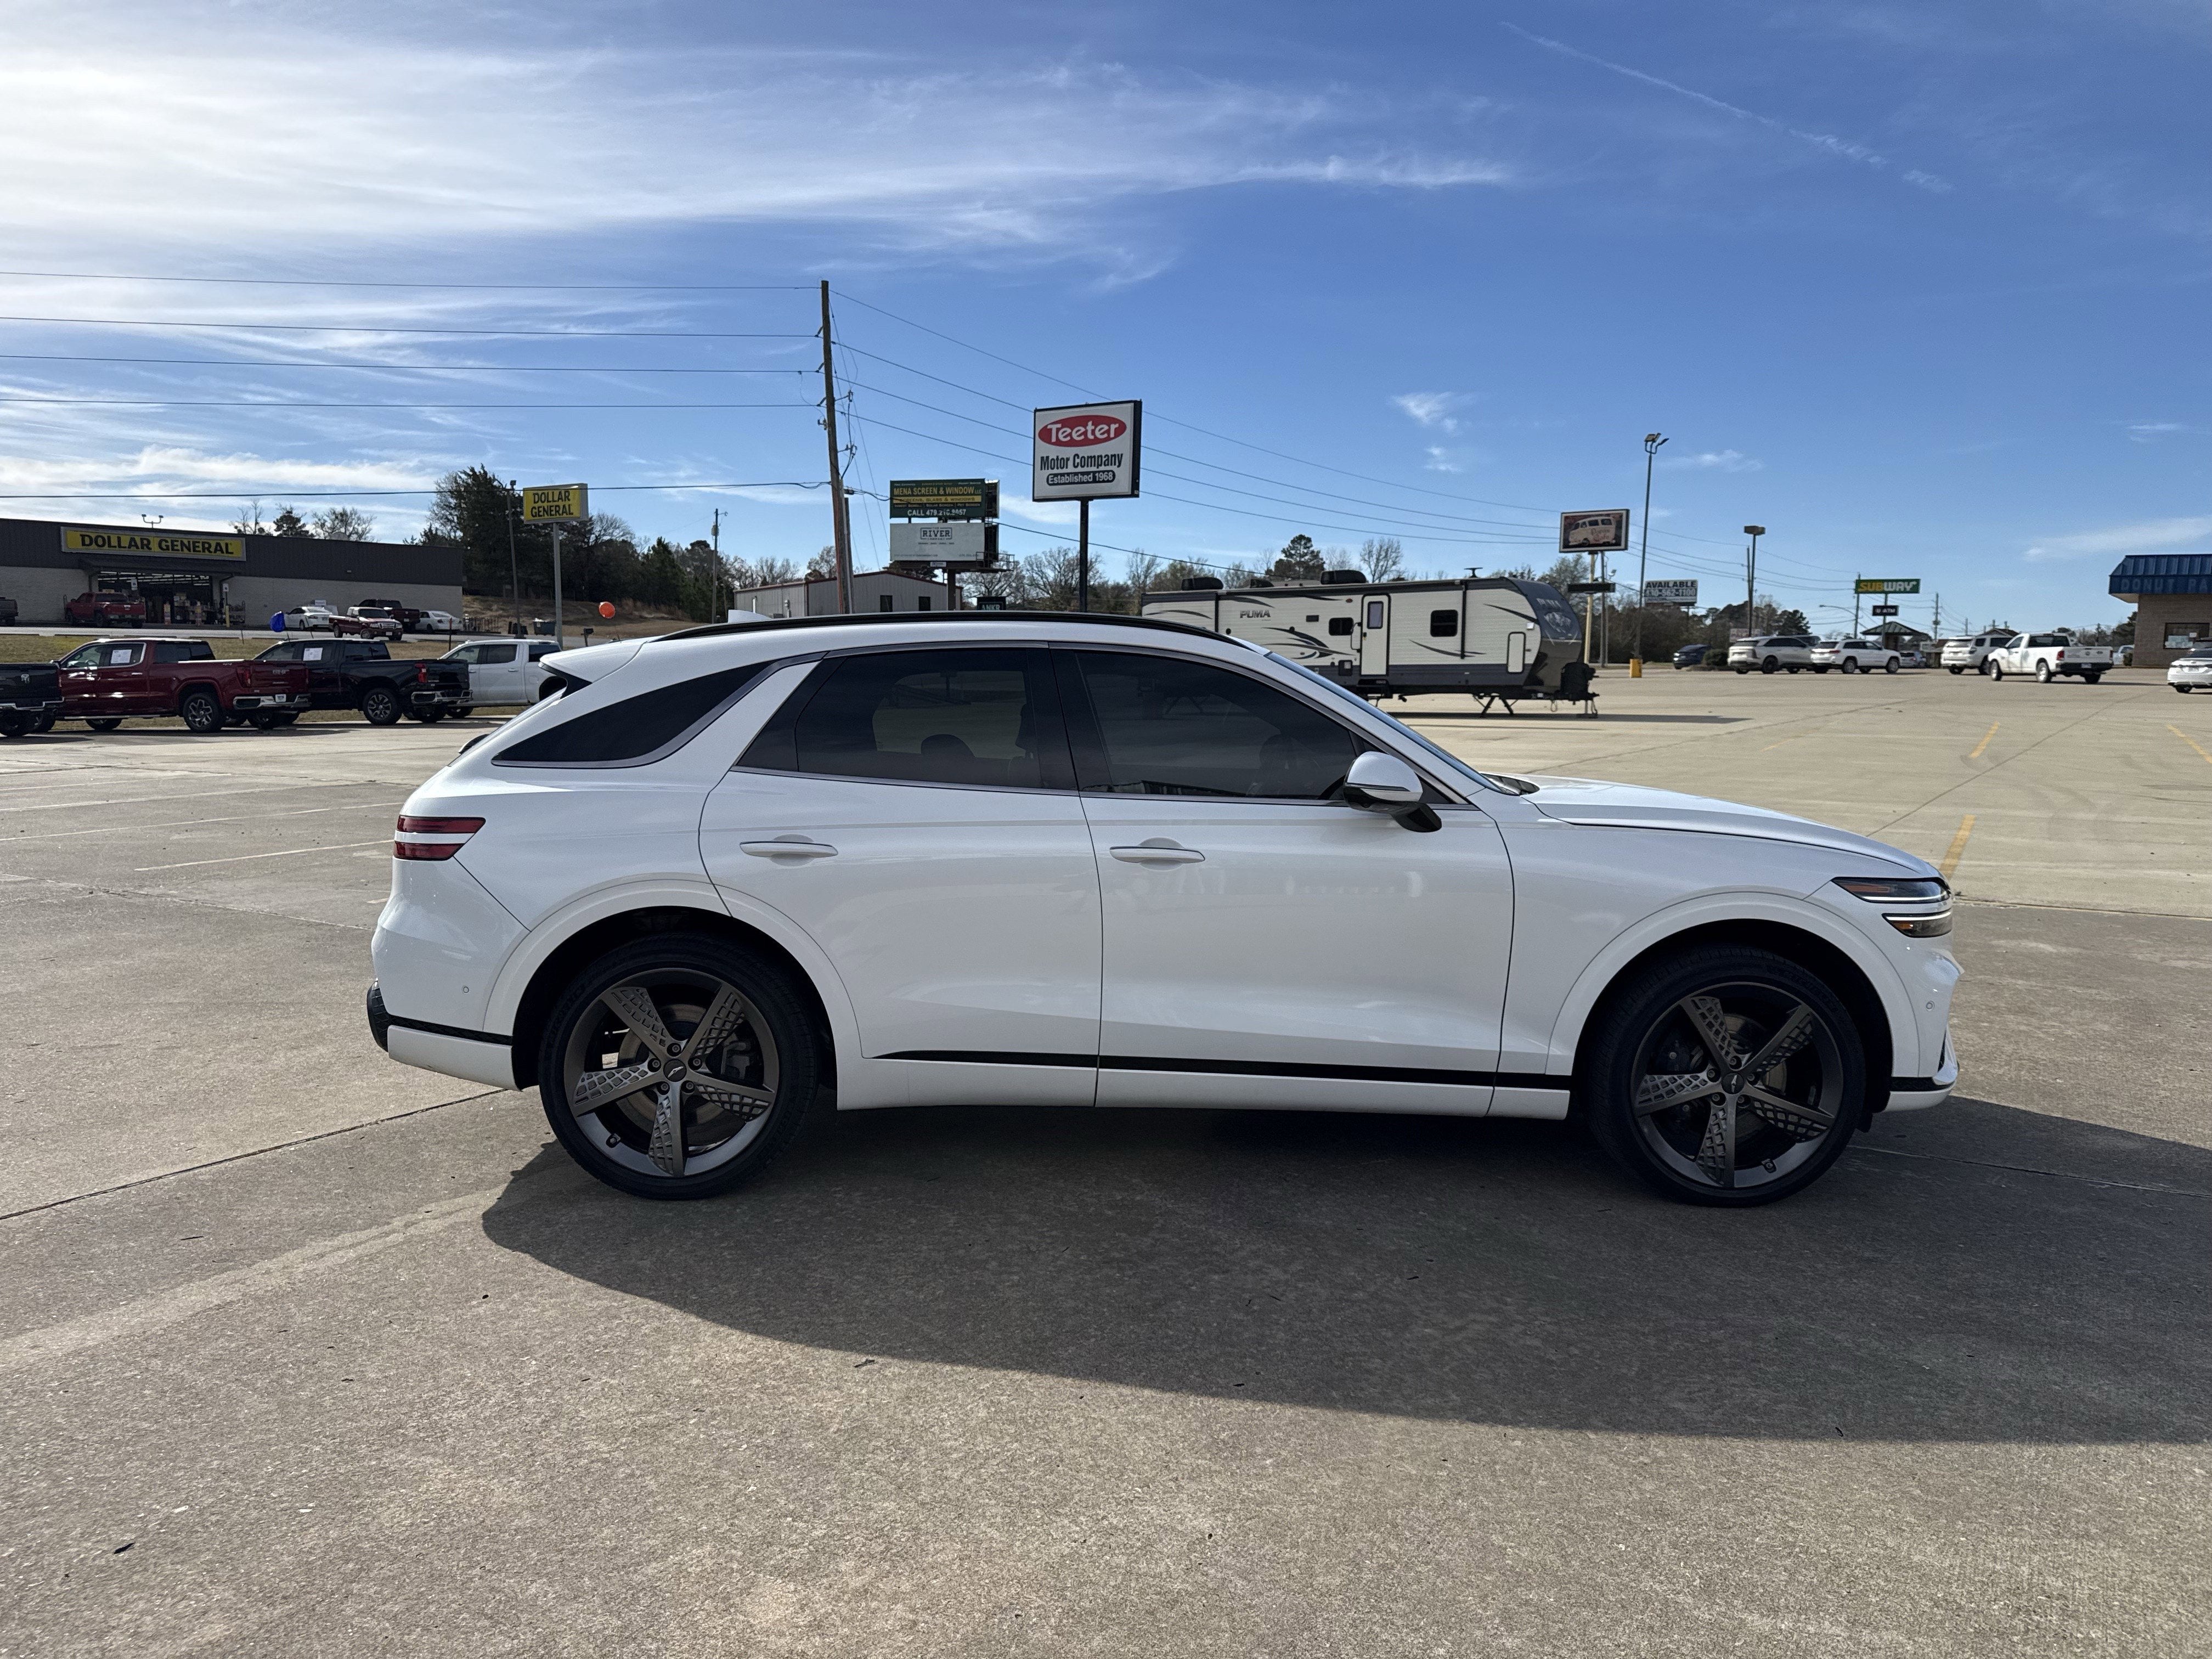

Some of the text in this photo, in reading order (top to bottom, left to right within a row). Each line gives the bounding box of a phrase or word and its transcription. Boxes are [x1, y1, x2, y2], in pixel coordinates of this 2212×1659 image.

[1047, 420, 1119, 443] Teeter
[1040, 453, 1124, 471] Motor Company
[1048, 471, 1114, 484] Established 1968
[532, 489, 571, 504] DOLLAR
[913, 487, 938, 495] SCREEN
[946, 486, 974, 494] WINDOW
[531, 504, 574, 517] GENERAL
[80, 534, 234, 554] DOLLAR GENERAL
[1858, 582, 1917, 591] SUBWAY
[2120, 578, 2175, 591] DONUT
[1240, 610, 1271, 618] PUMA
